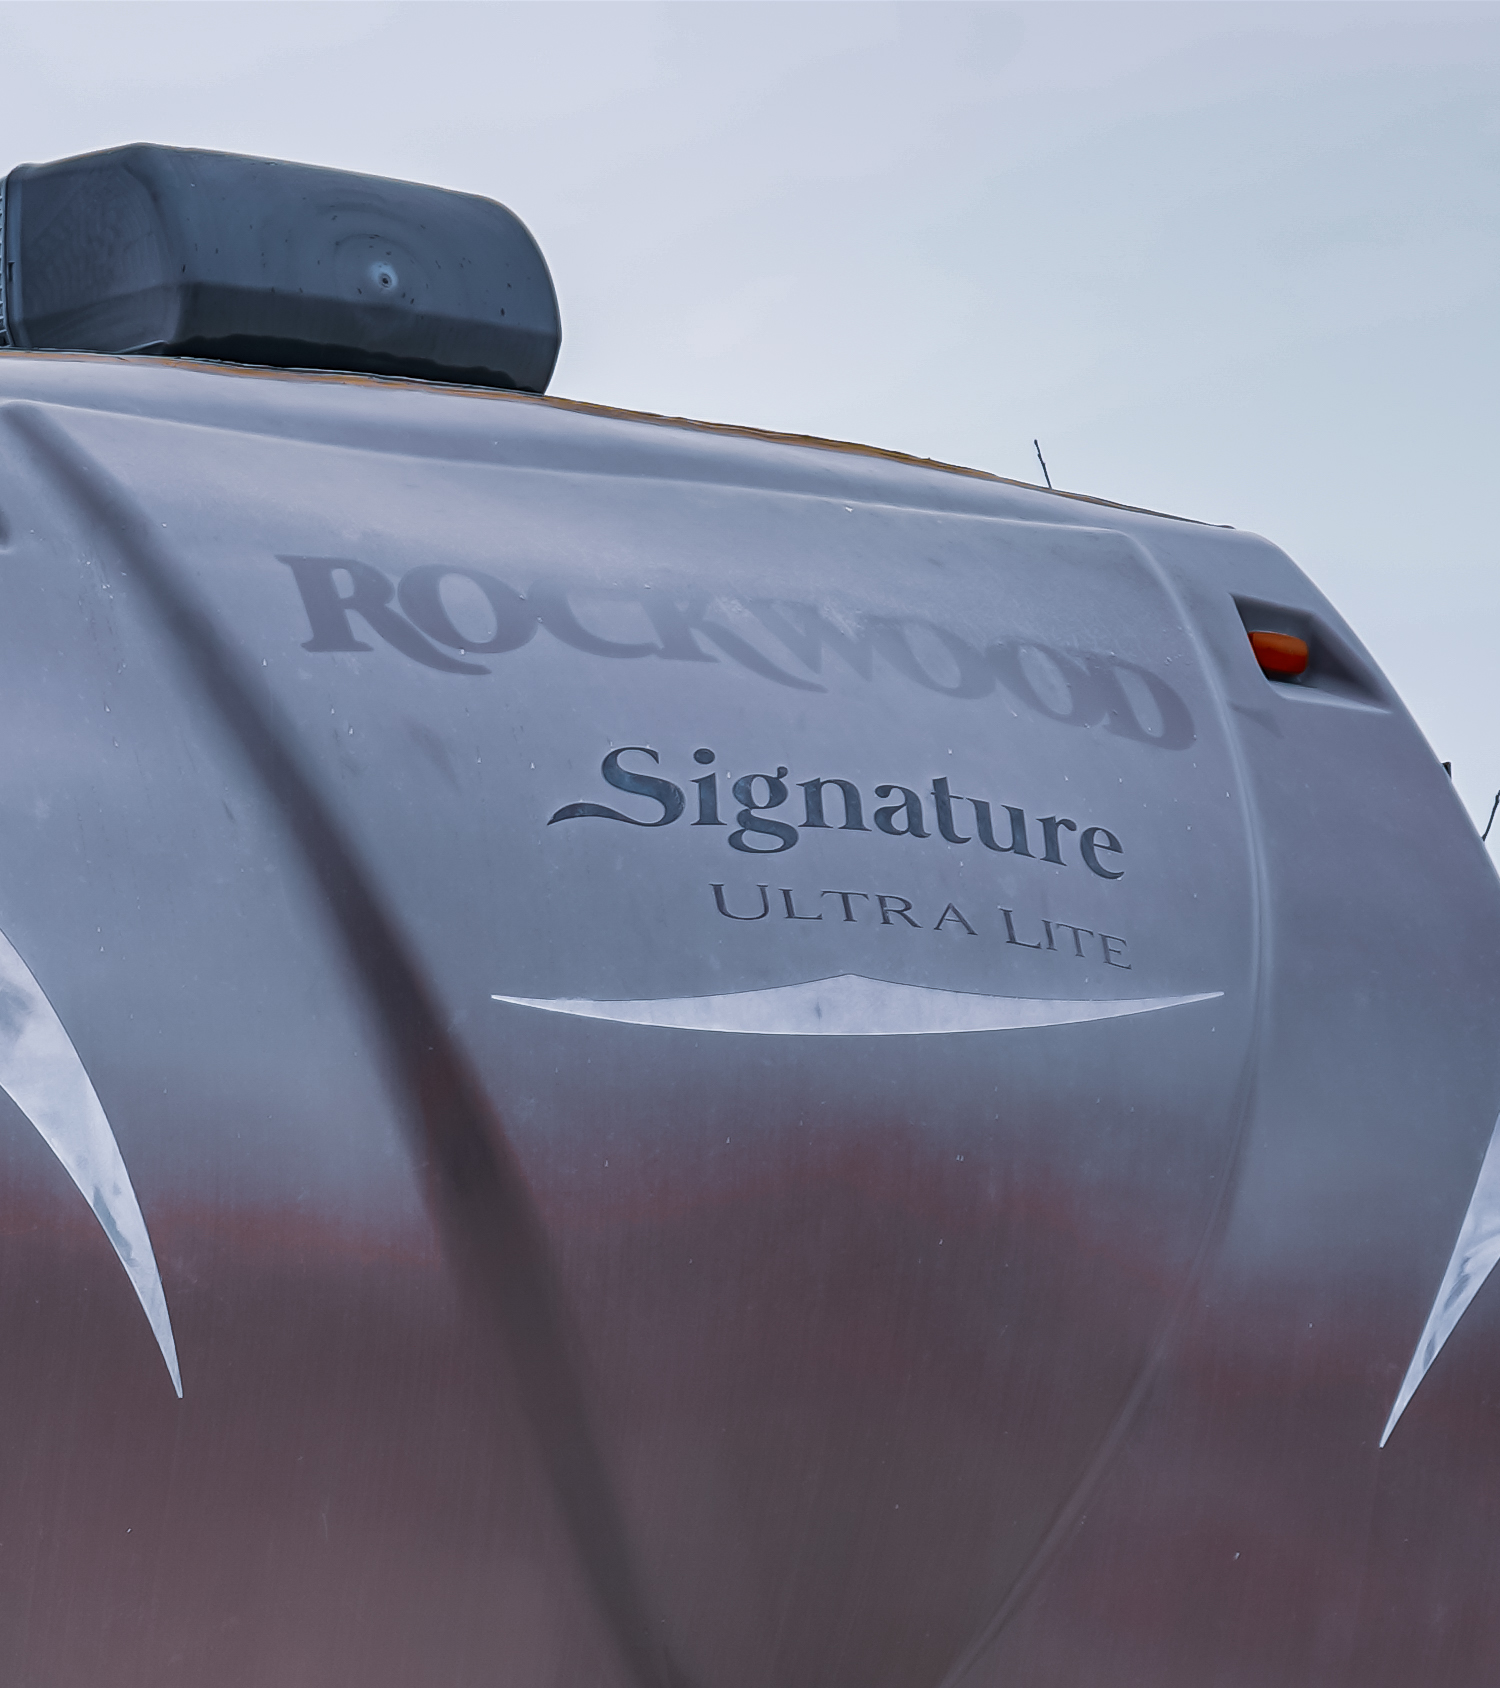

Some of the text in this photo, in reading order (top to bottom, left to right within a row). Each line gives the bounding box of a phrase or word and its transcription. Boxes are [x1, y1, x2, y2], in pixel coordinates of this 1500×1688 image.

[273, 553, 1197, 751] ROCKWOOD
[546, 745, 1125, 880] Signature
[708, 881, 1132, 971] ULTRA LITE
